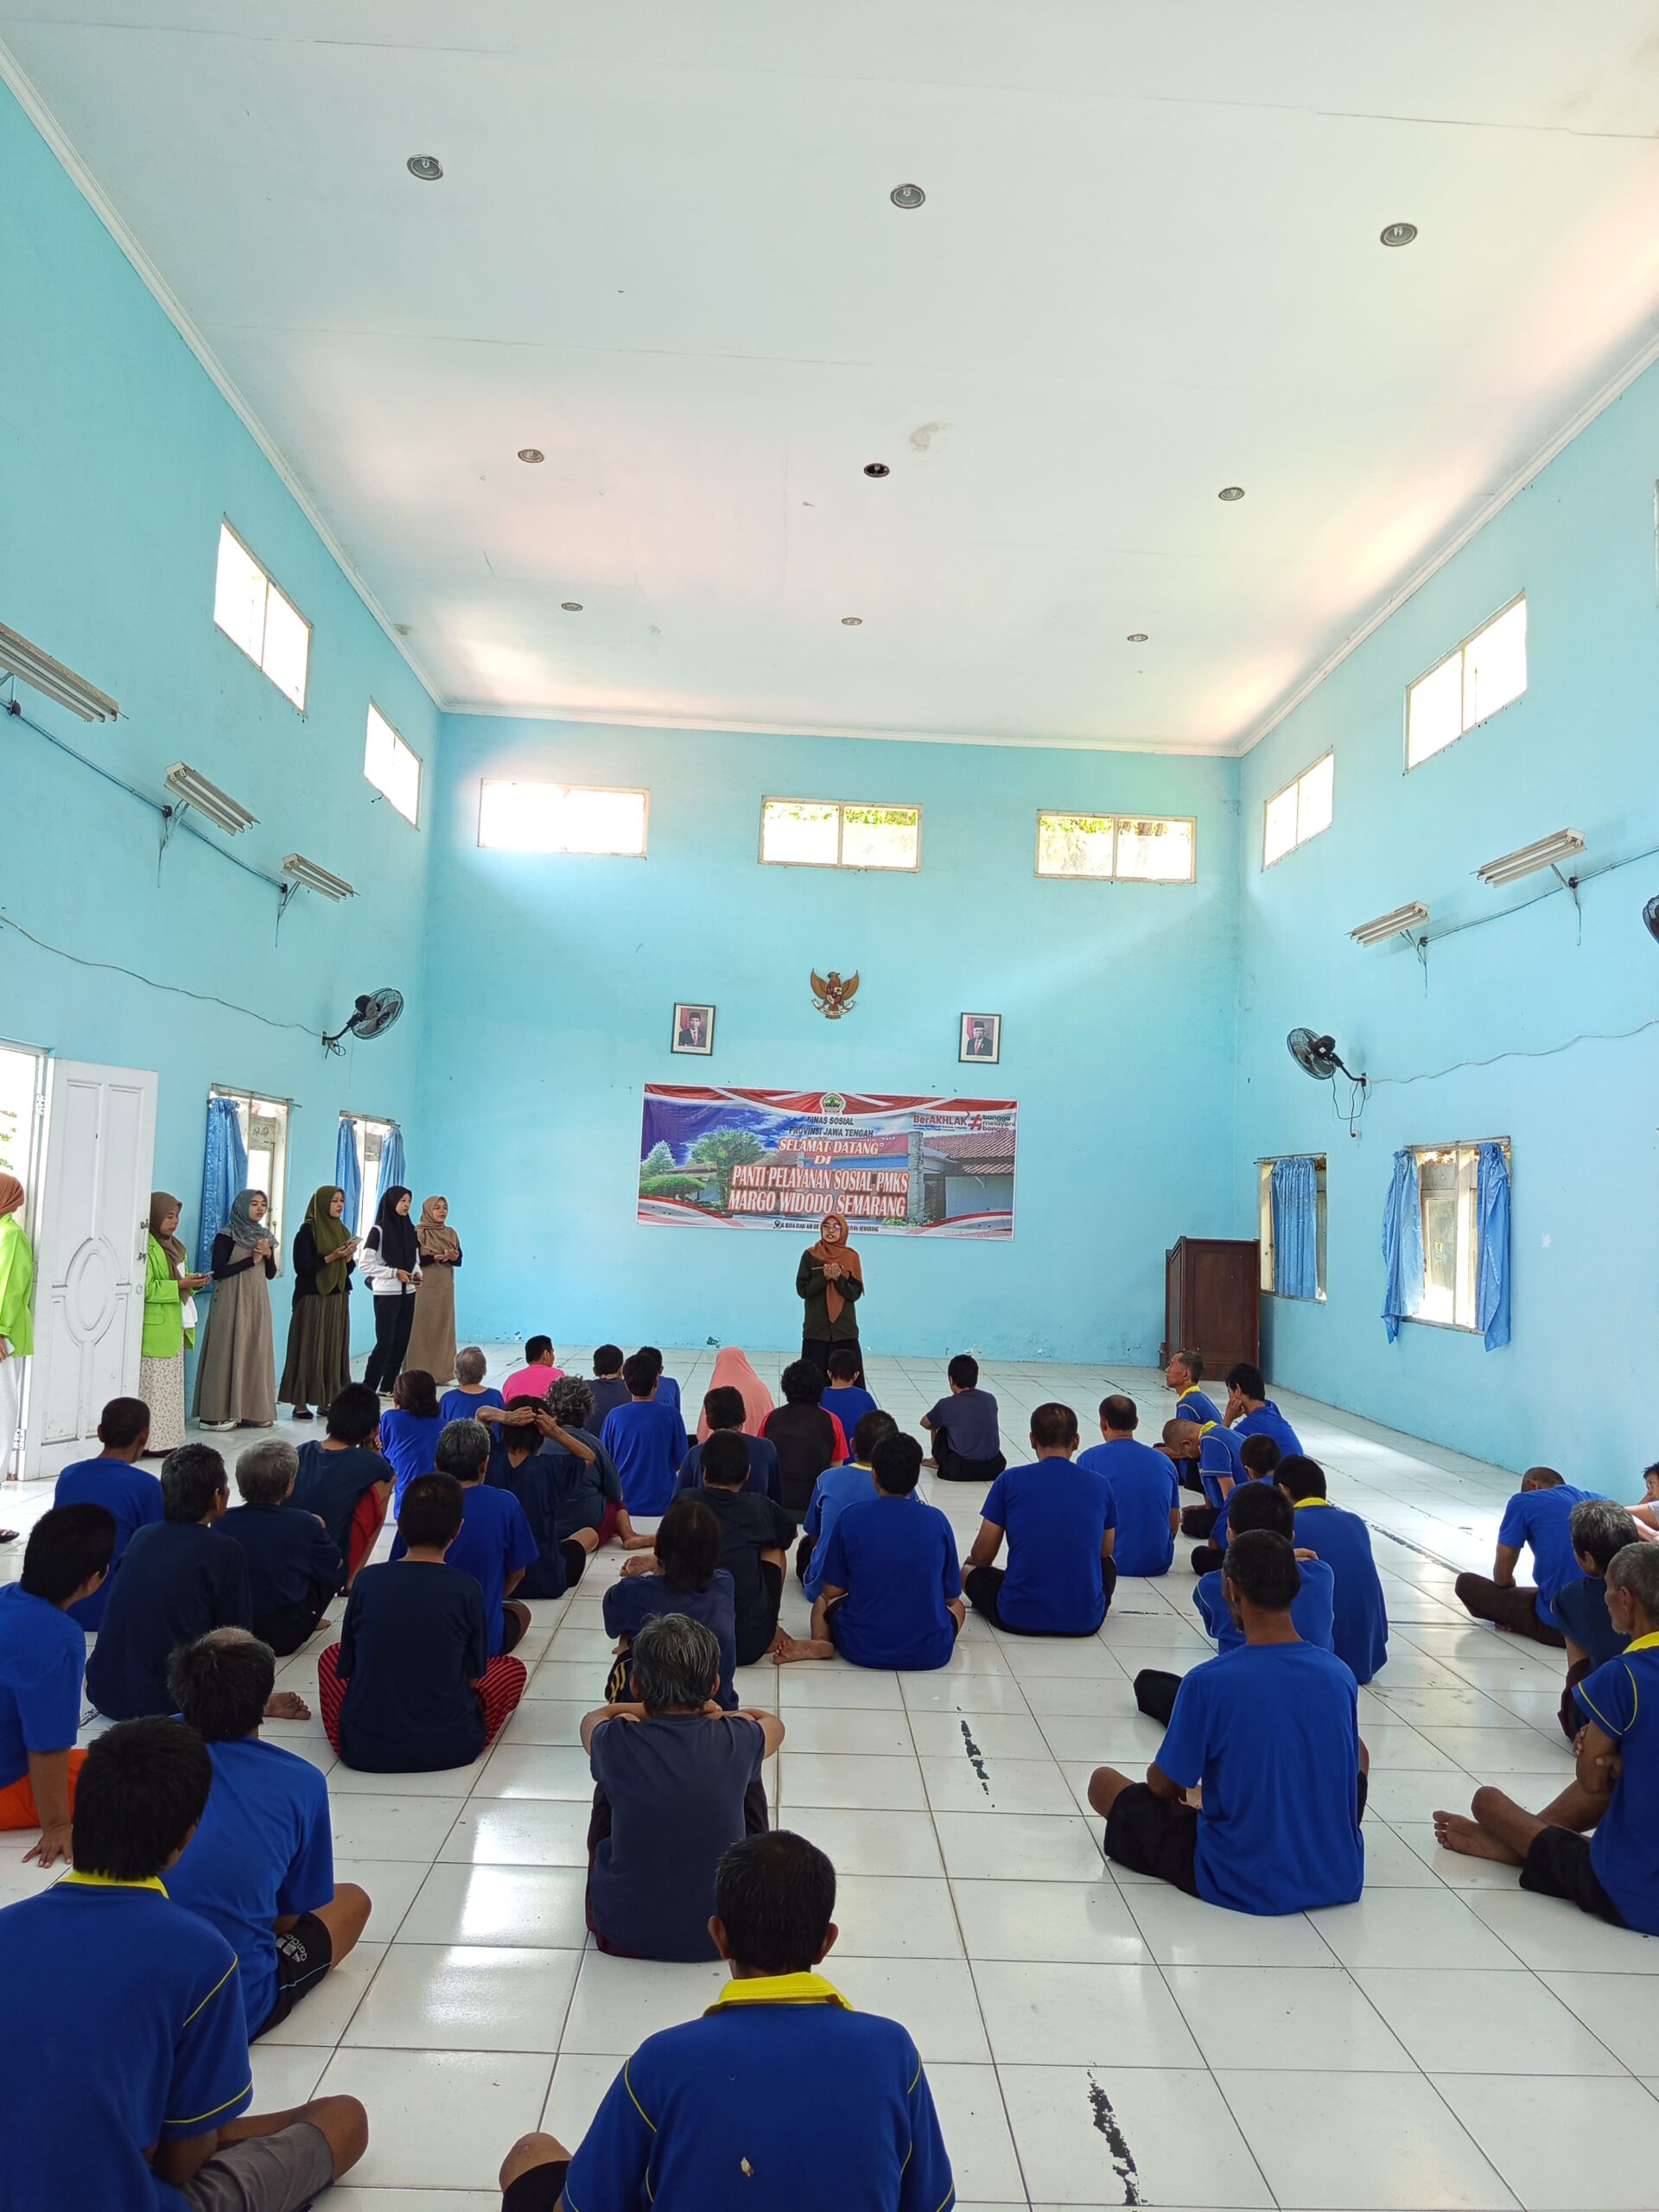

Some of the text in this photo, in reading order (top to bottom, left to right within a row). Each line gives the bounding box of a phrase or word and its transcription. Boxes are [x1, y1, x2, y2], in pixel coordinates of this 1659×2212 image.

[807, 1116, 855, 1126] DINAS SOSIAL
[913, 1113, 969, 1126] BerAKHLAK
[789, 1126, 874, 1138] PROVINSI JAWA TENGAH
[779, 1138, 879, 1155] SELAMAT DATANG
[814, 1155, 831, 1165] DI
[732, 1165, 910, 1194] PANTI PELAYANAN SOSIAL PMKS
[728, 1189, 906, 1217] MARGO WIDODO SEMARANG
[283, 1933, 308, 1961] adida
